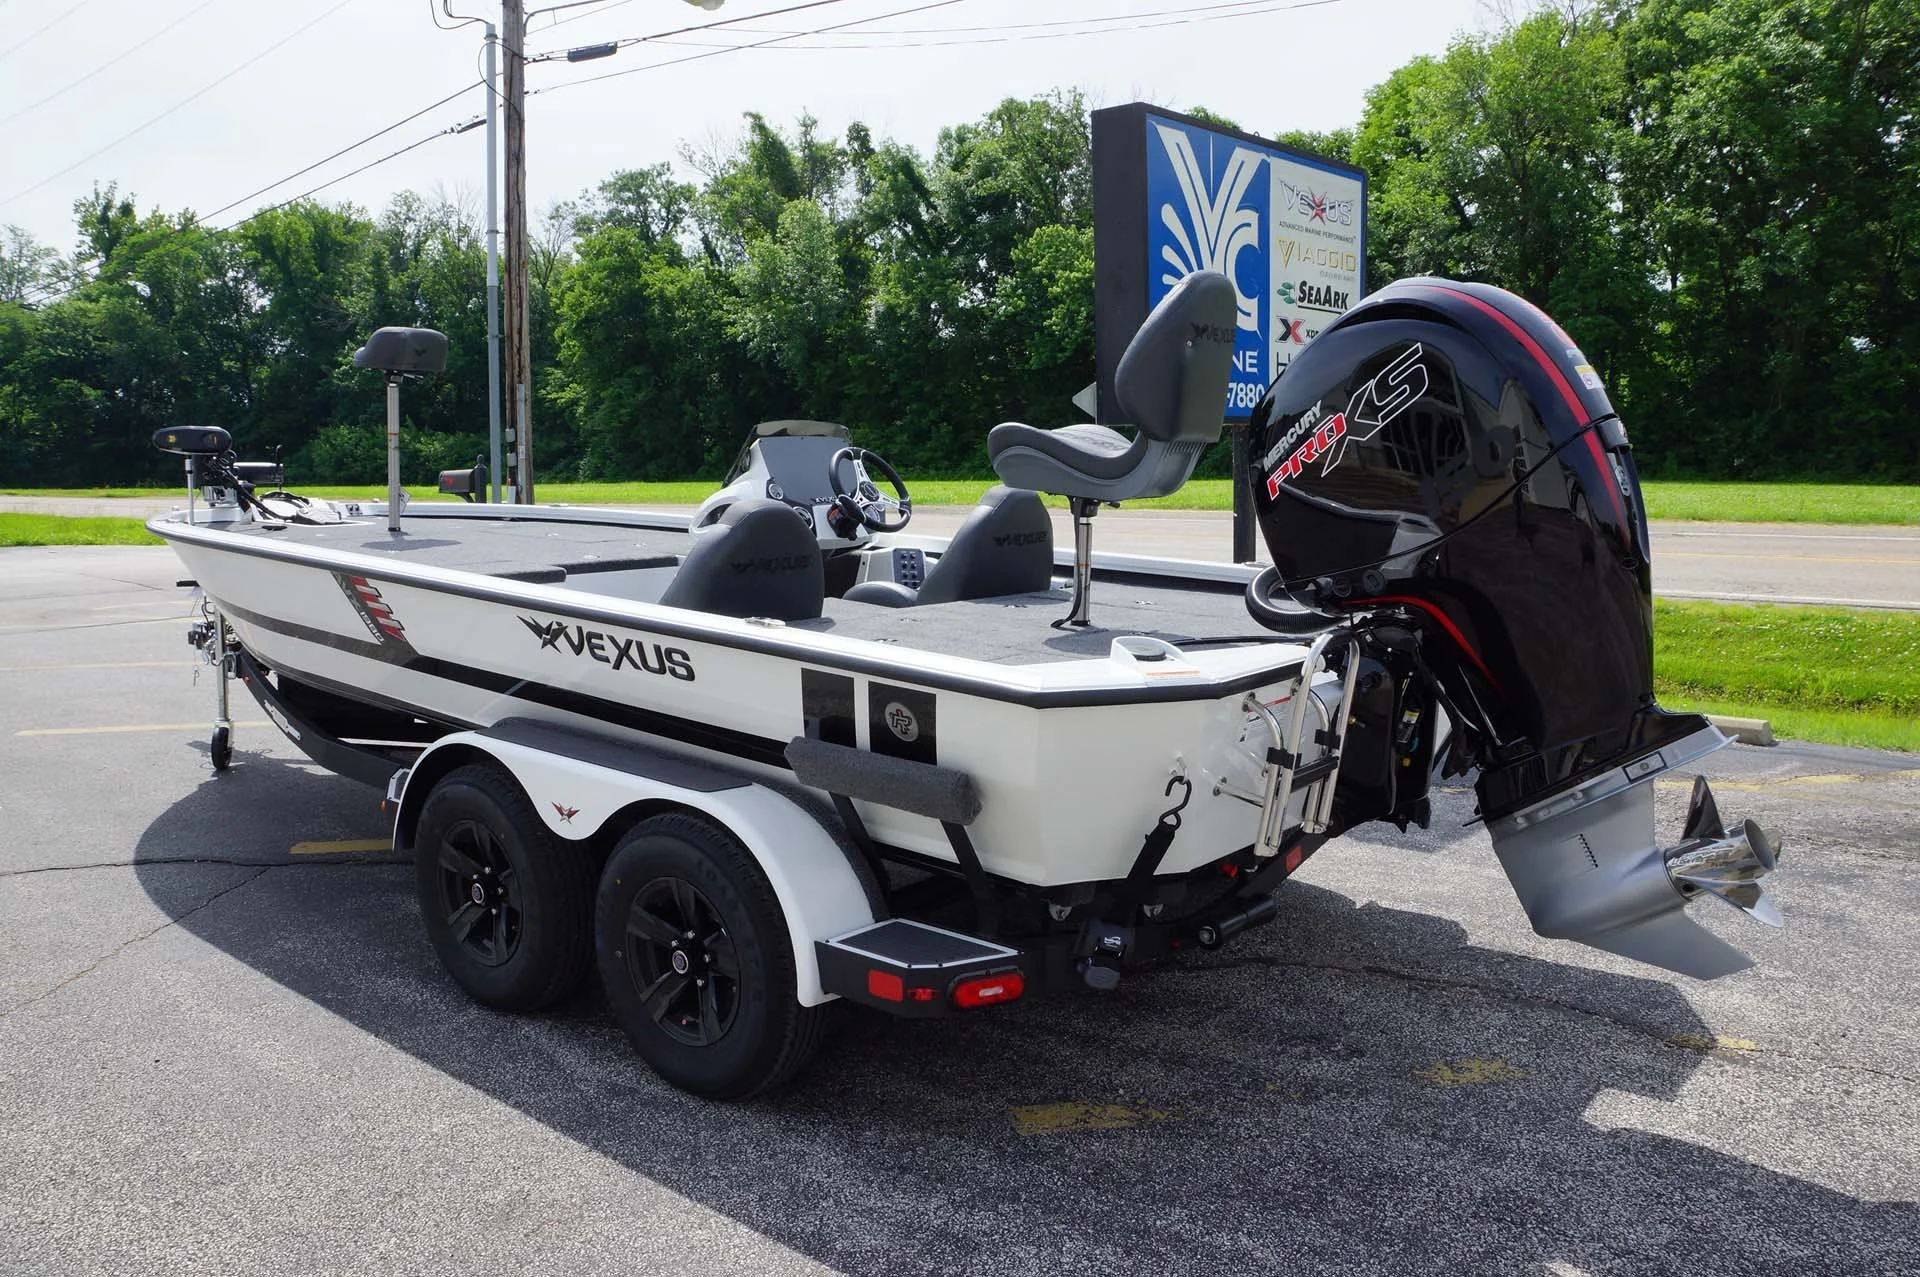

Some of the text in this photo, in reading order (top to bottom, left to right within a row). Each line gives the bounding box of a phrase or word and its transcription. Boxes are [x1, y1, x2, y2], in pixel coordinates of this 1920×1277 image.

[1278, 180, 1354, 226] VEXUS
[1277, 237, 1356, 272] VIAGGIO
[1263, 400, 1322, 472] MERCURY
[1267, 342, 1429, 501] PRO XS
[555, 621, 696, 682] VEXUS
